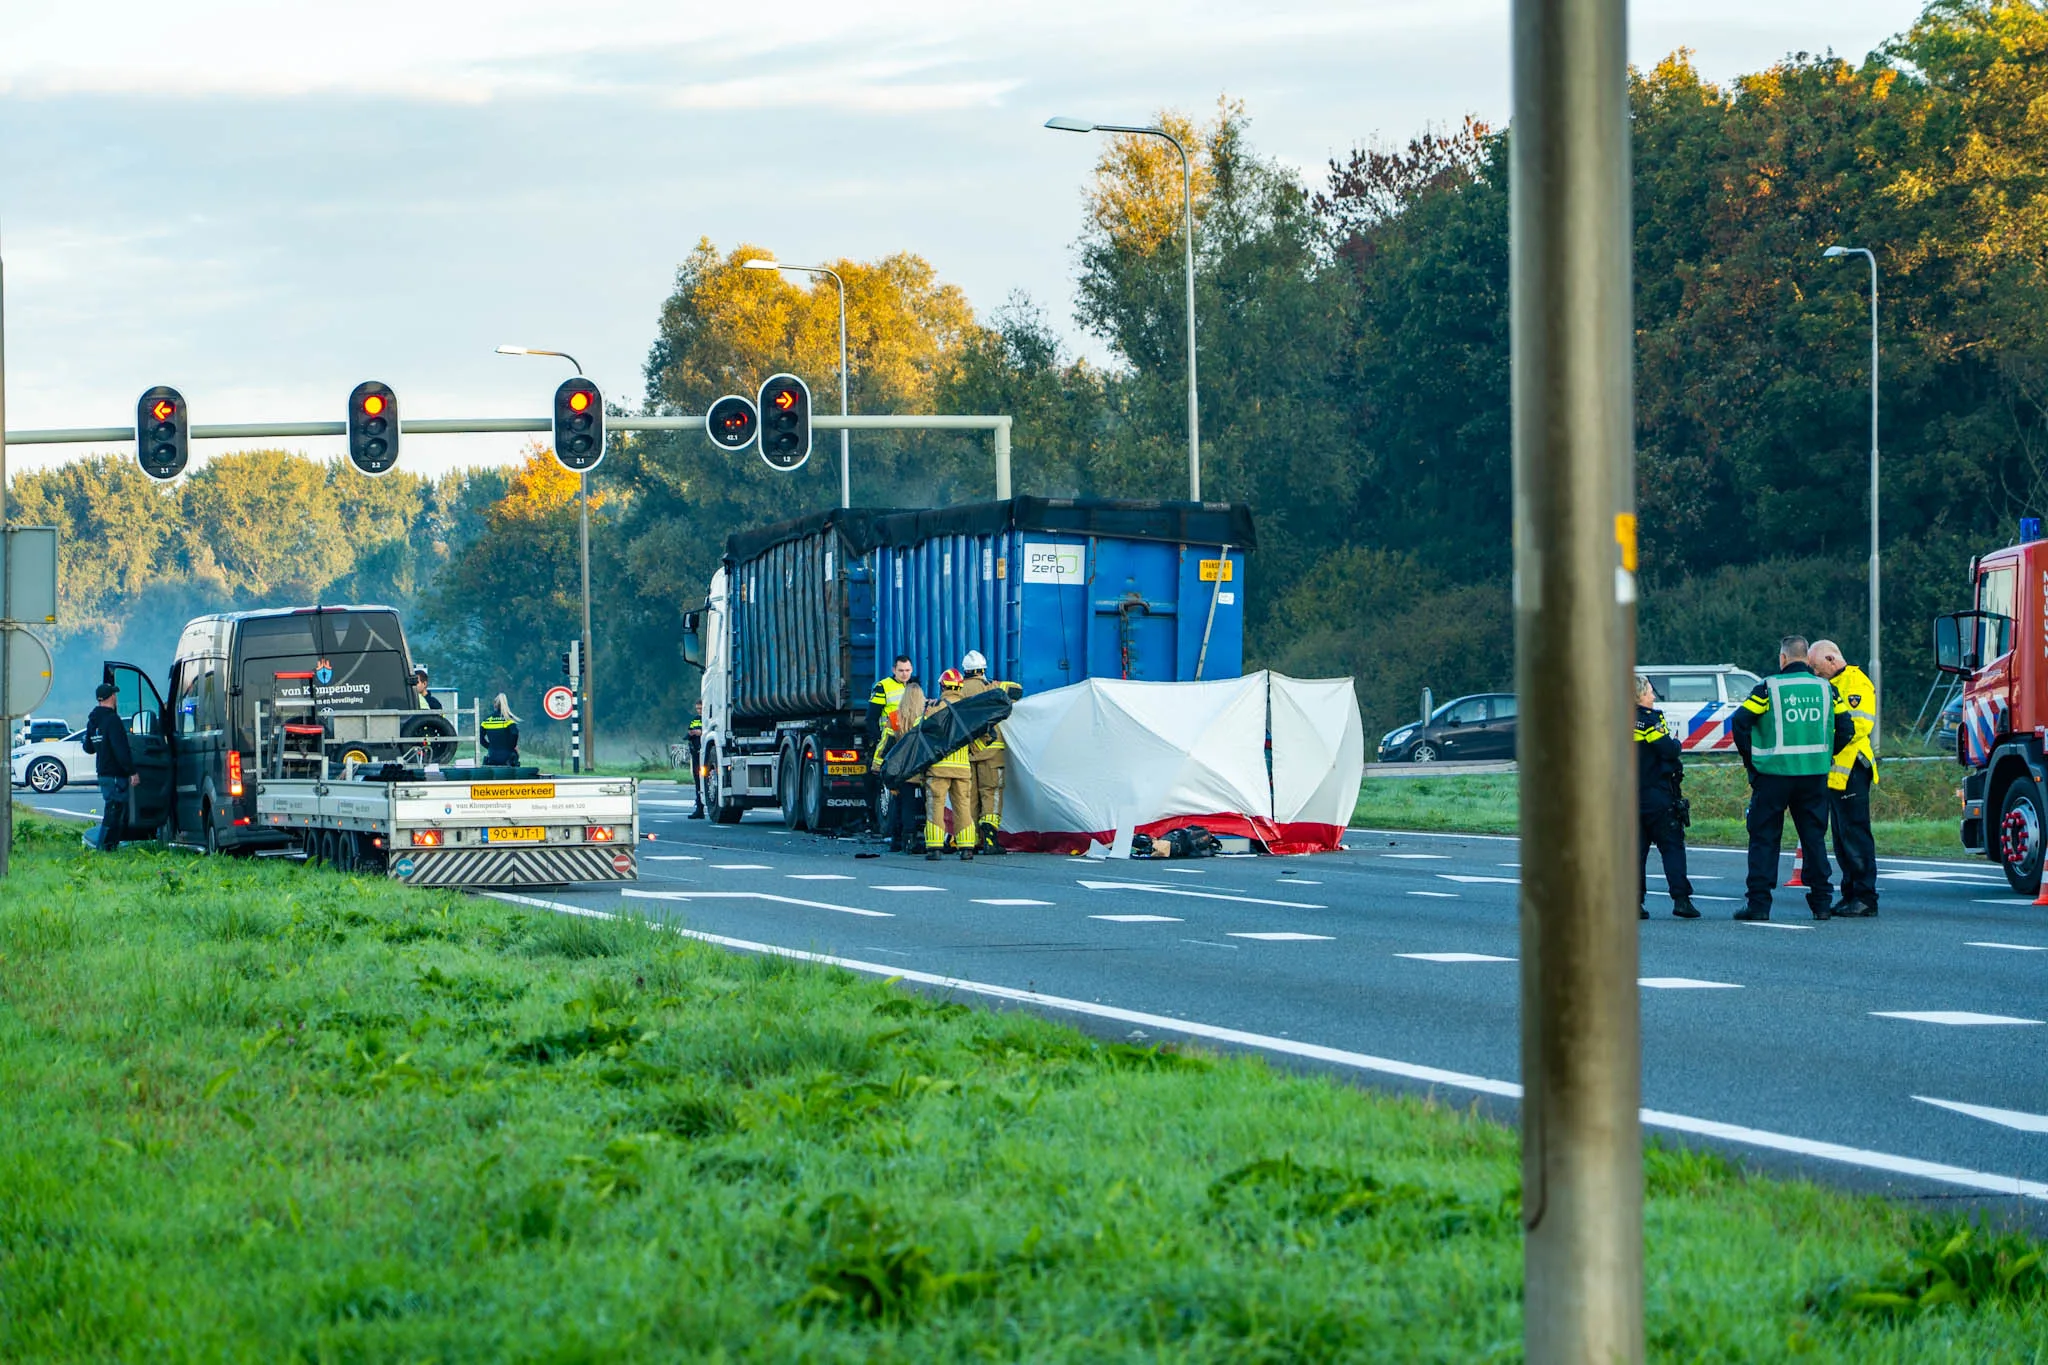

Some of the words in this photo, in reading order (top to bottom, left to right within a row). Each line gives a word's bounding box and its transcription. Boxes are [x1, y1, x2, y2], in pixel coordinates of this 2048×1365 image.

[1031, 553, 1056, 563] pre
[1031, 565, 1065, 574] zero
[281, 688, 301, 696] van
[302, 683, 370, 696] Kompenburg
[1785, 708, 1821, 722] OVD
[473, 786, 553, 797] hekwerkverkeer
[827, 799, 867, 807] SCANIA
[493, 827, 540, 839] 90-WJT-1
